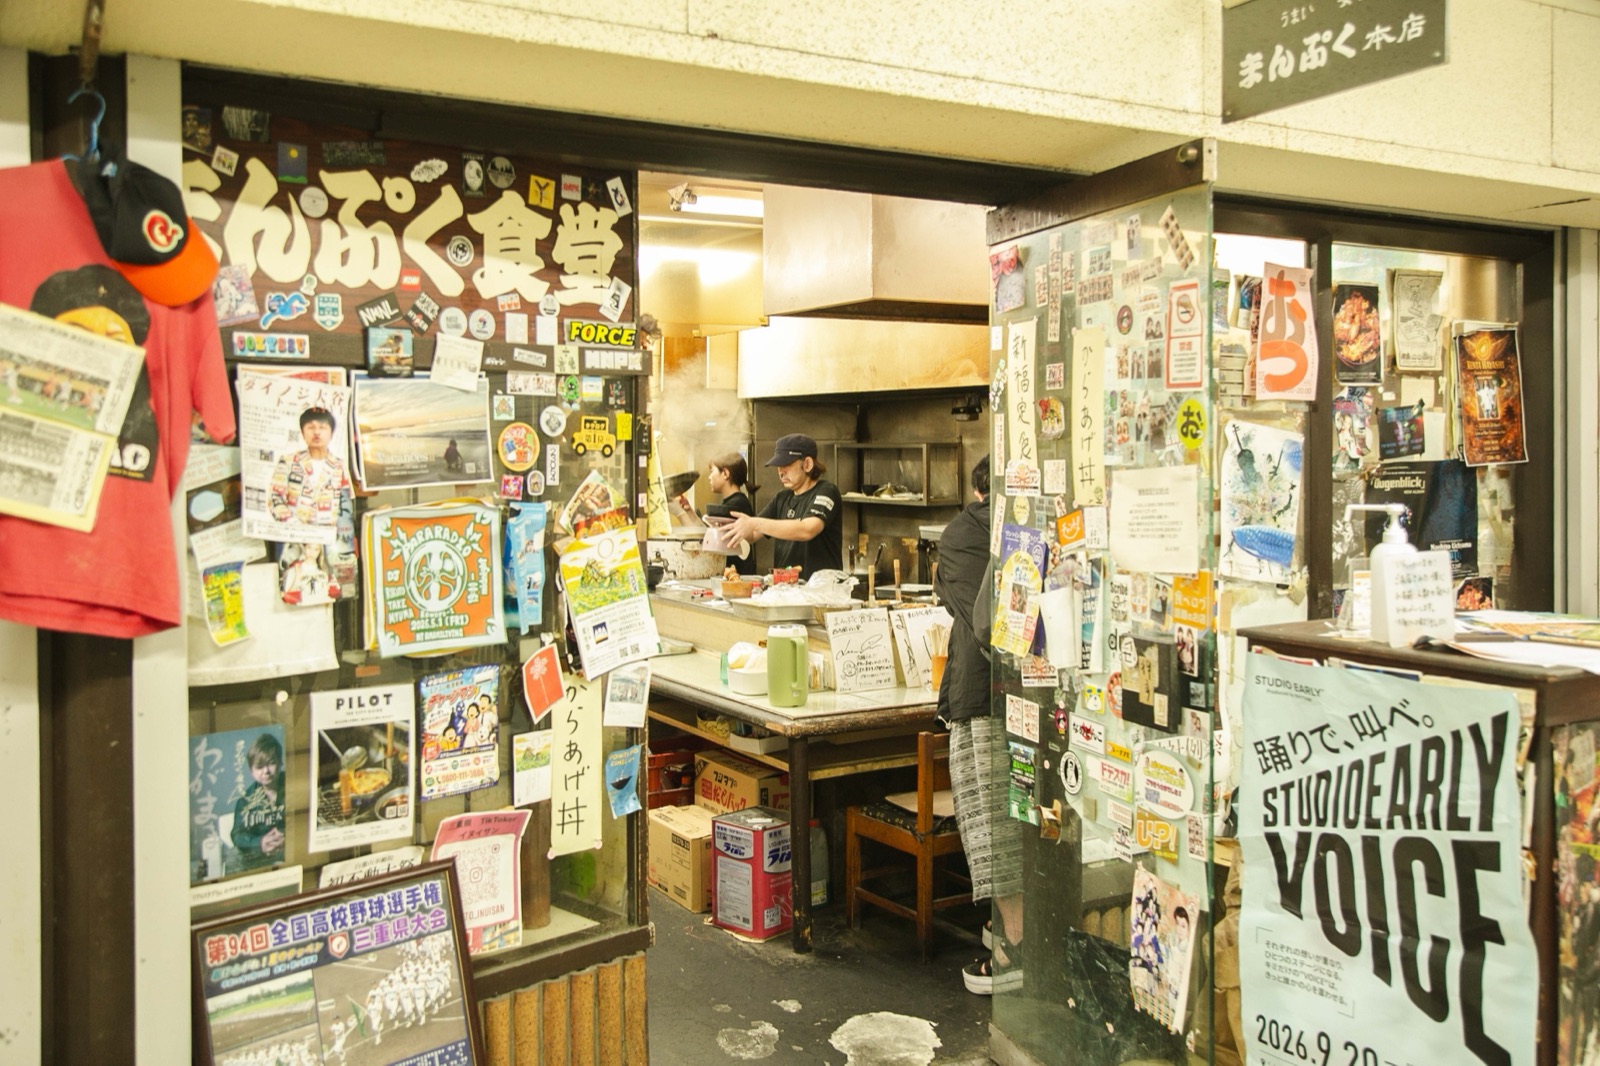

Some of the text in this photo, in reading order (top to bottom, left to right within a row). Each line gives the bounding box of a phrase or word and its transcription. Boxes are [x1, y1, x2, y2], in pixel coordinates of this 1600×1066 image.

[570, 321, 637, 346] FORCE
[1078, 345, 1096, 488] からあげ丼
[336, 693, 393, 710] PILOT
[556, 684, 590, 836] からあげ丼
[1253, 699, 1435, 775] 踊りで、叫べ。
[481, 816, 517, 825] TikToker
[205, 882, 442, 966] 第94回全国高校野球選手権
[354, 908, 447, 951] 三重県大会
[464, 904, 505, 920] TO_INUISAN
[1264, 831, 1512, 1066] VOICE
